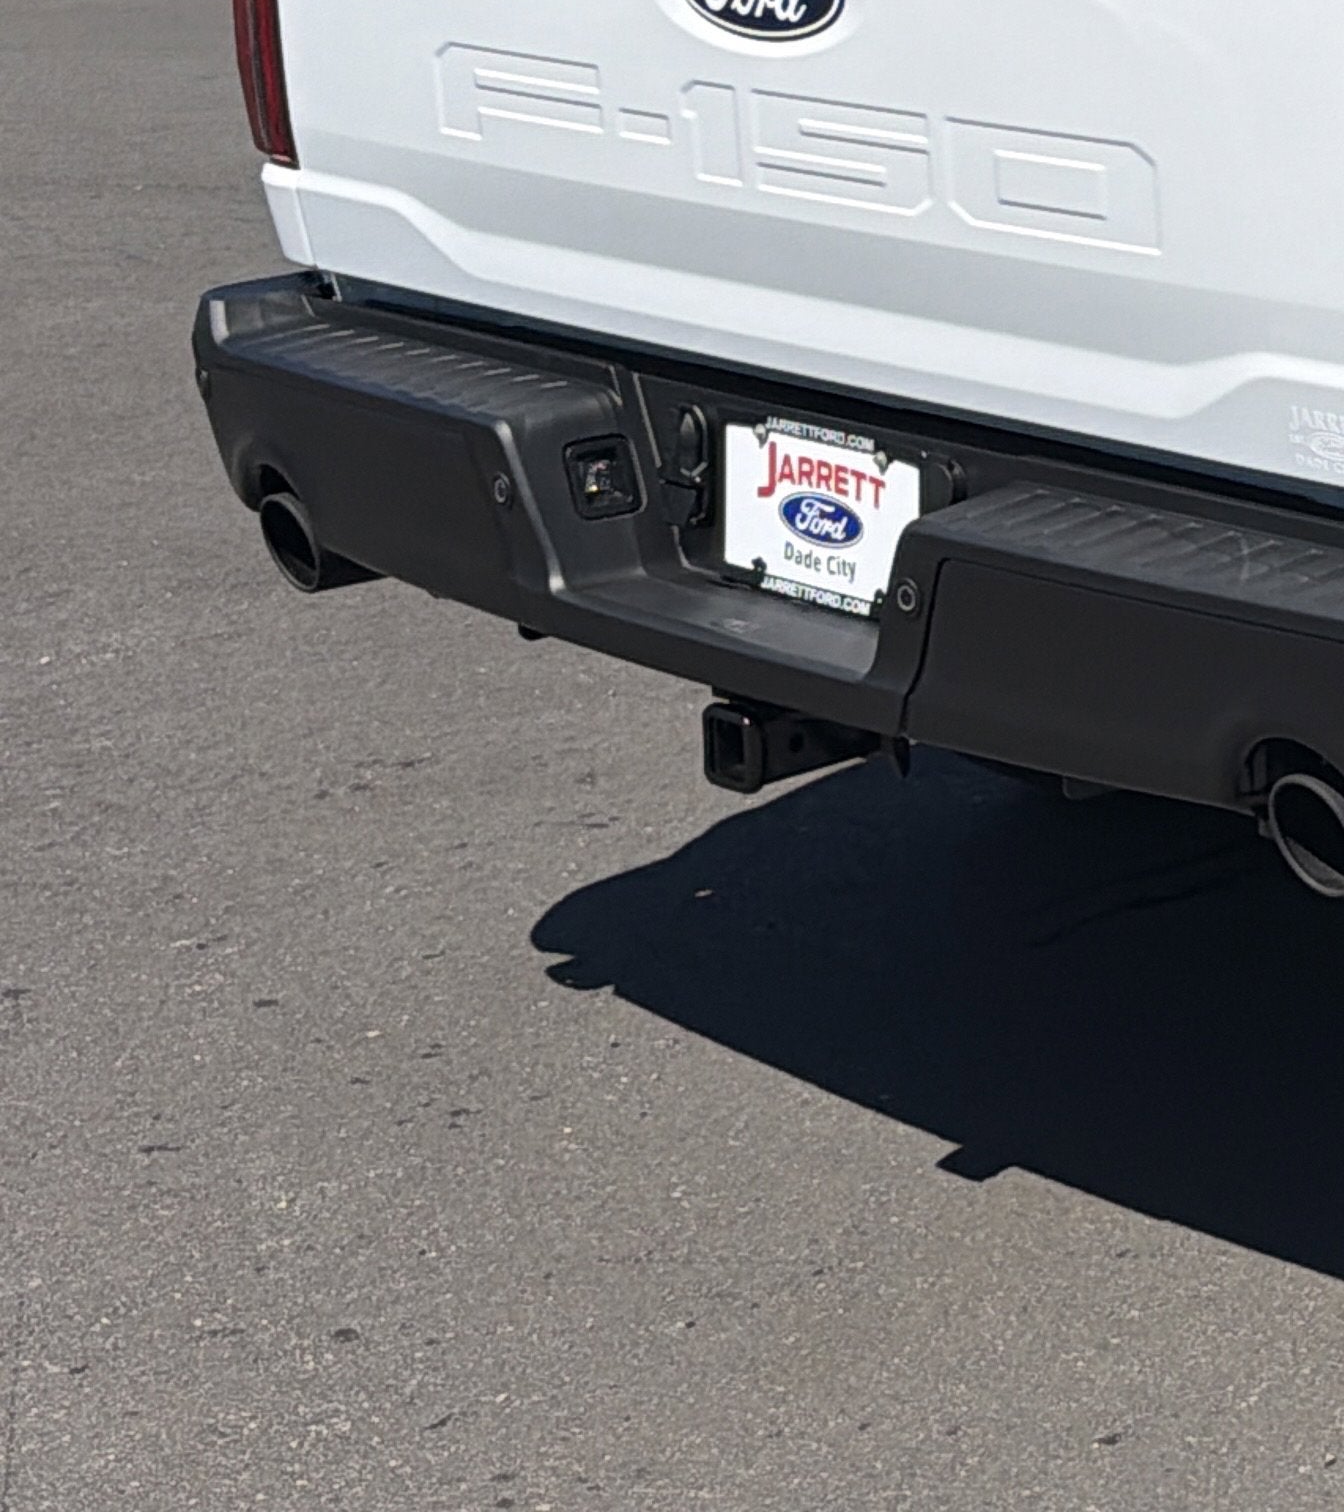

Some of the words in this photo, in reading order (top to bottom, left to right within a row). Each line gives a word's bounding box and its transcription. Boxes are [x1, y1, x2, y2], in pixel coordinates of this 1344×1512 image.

[433, 40, 1163, 257] F-150
[766, 415, 876, 451] JARRETTFORD.COM
[757, 440, 887, 510] JARRETT
[795, 498, 848, 541] Ford
[783, 540, 822, 574] Dade
[826, 555, 857, 585] City
[760, 574, 871, 617] JARRETTFORD.COM
